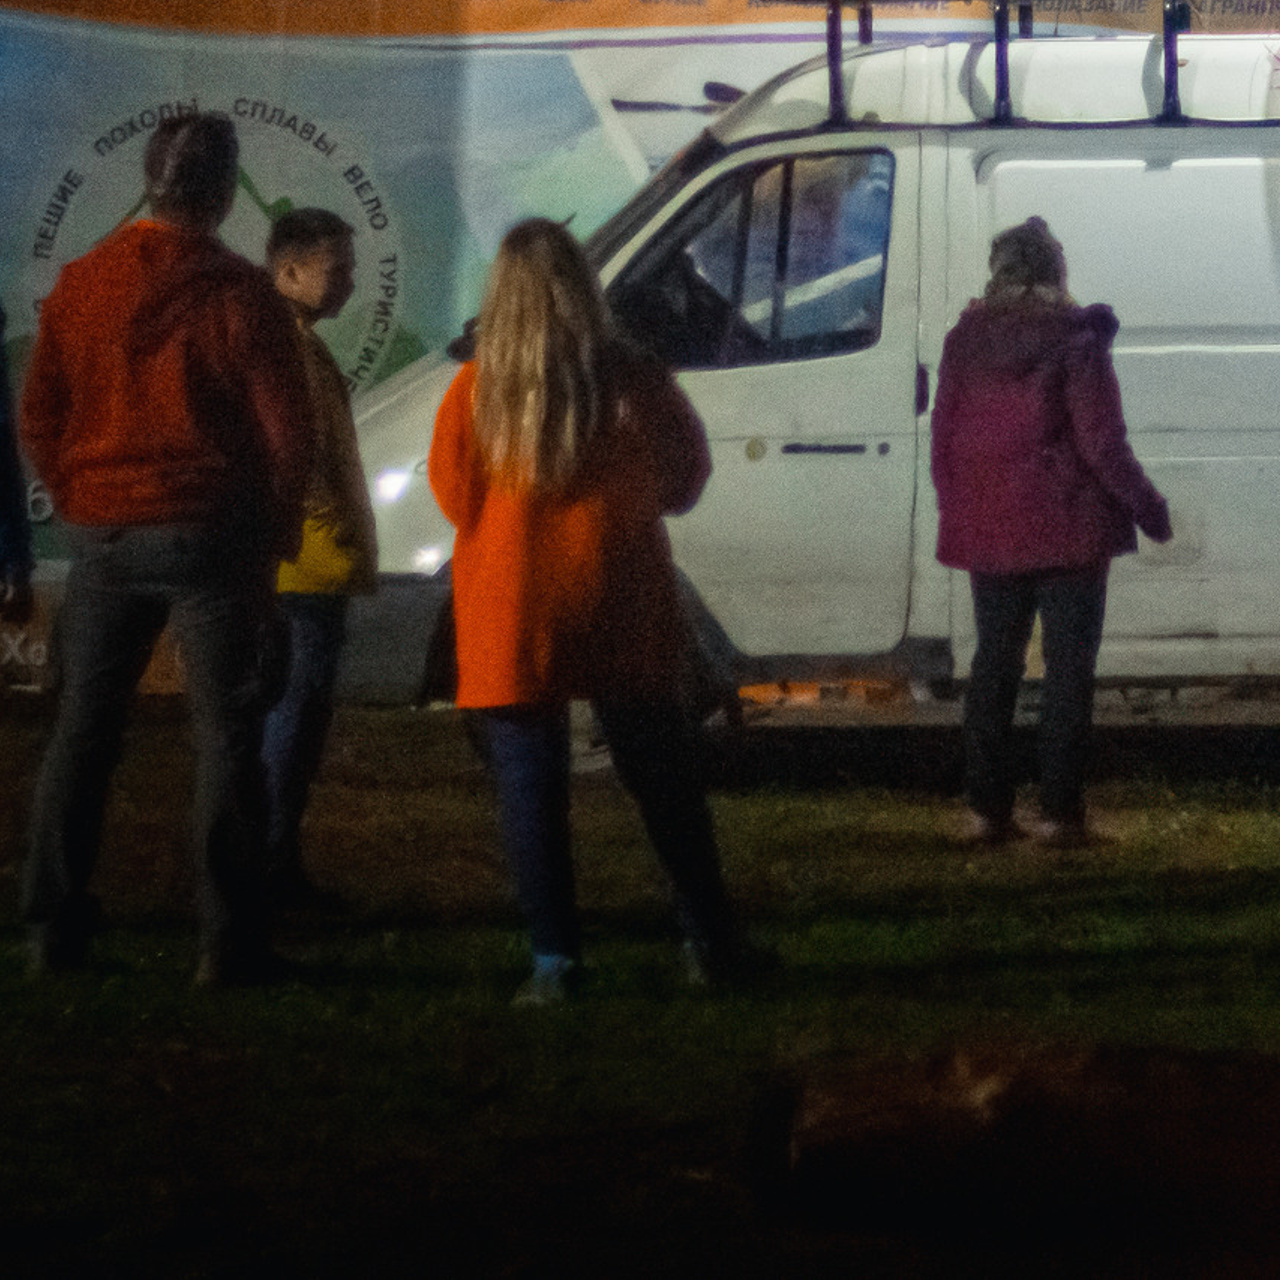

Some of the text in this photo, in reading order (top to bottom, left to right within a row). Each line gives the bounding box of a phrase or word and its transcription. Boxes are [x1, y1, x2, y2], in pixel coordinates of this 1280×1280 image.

[33, 169, 84, 259] ПЕШИЕ
[94, 98, 199, 157] ПОХОДЫ
[233, 97, 338, 157] СПЛАВЫ
[343, 164, 389, 231] ВЕЛО
